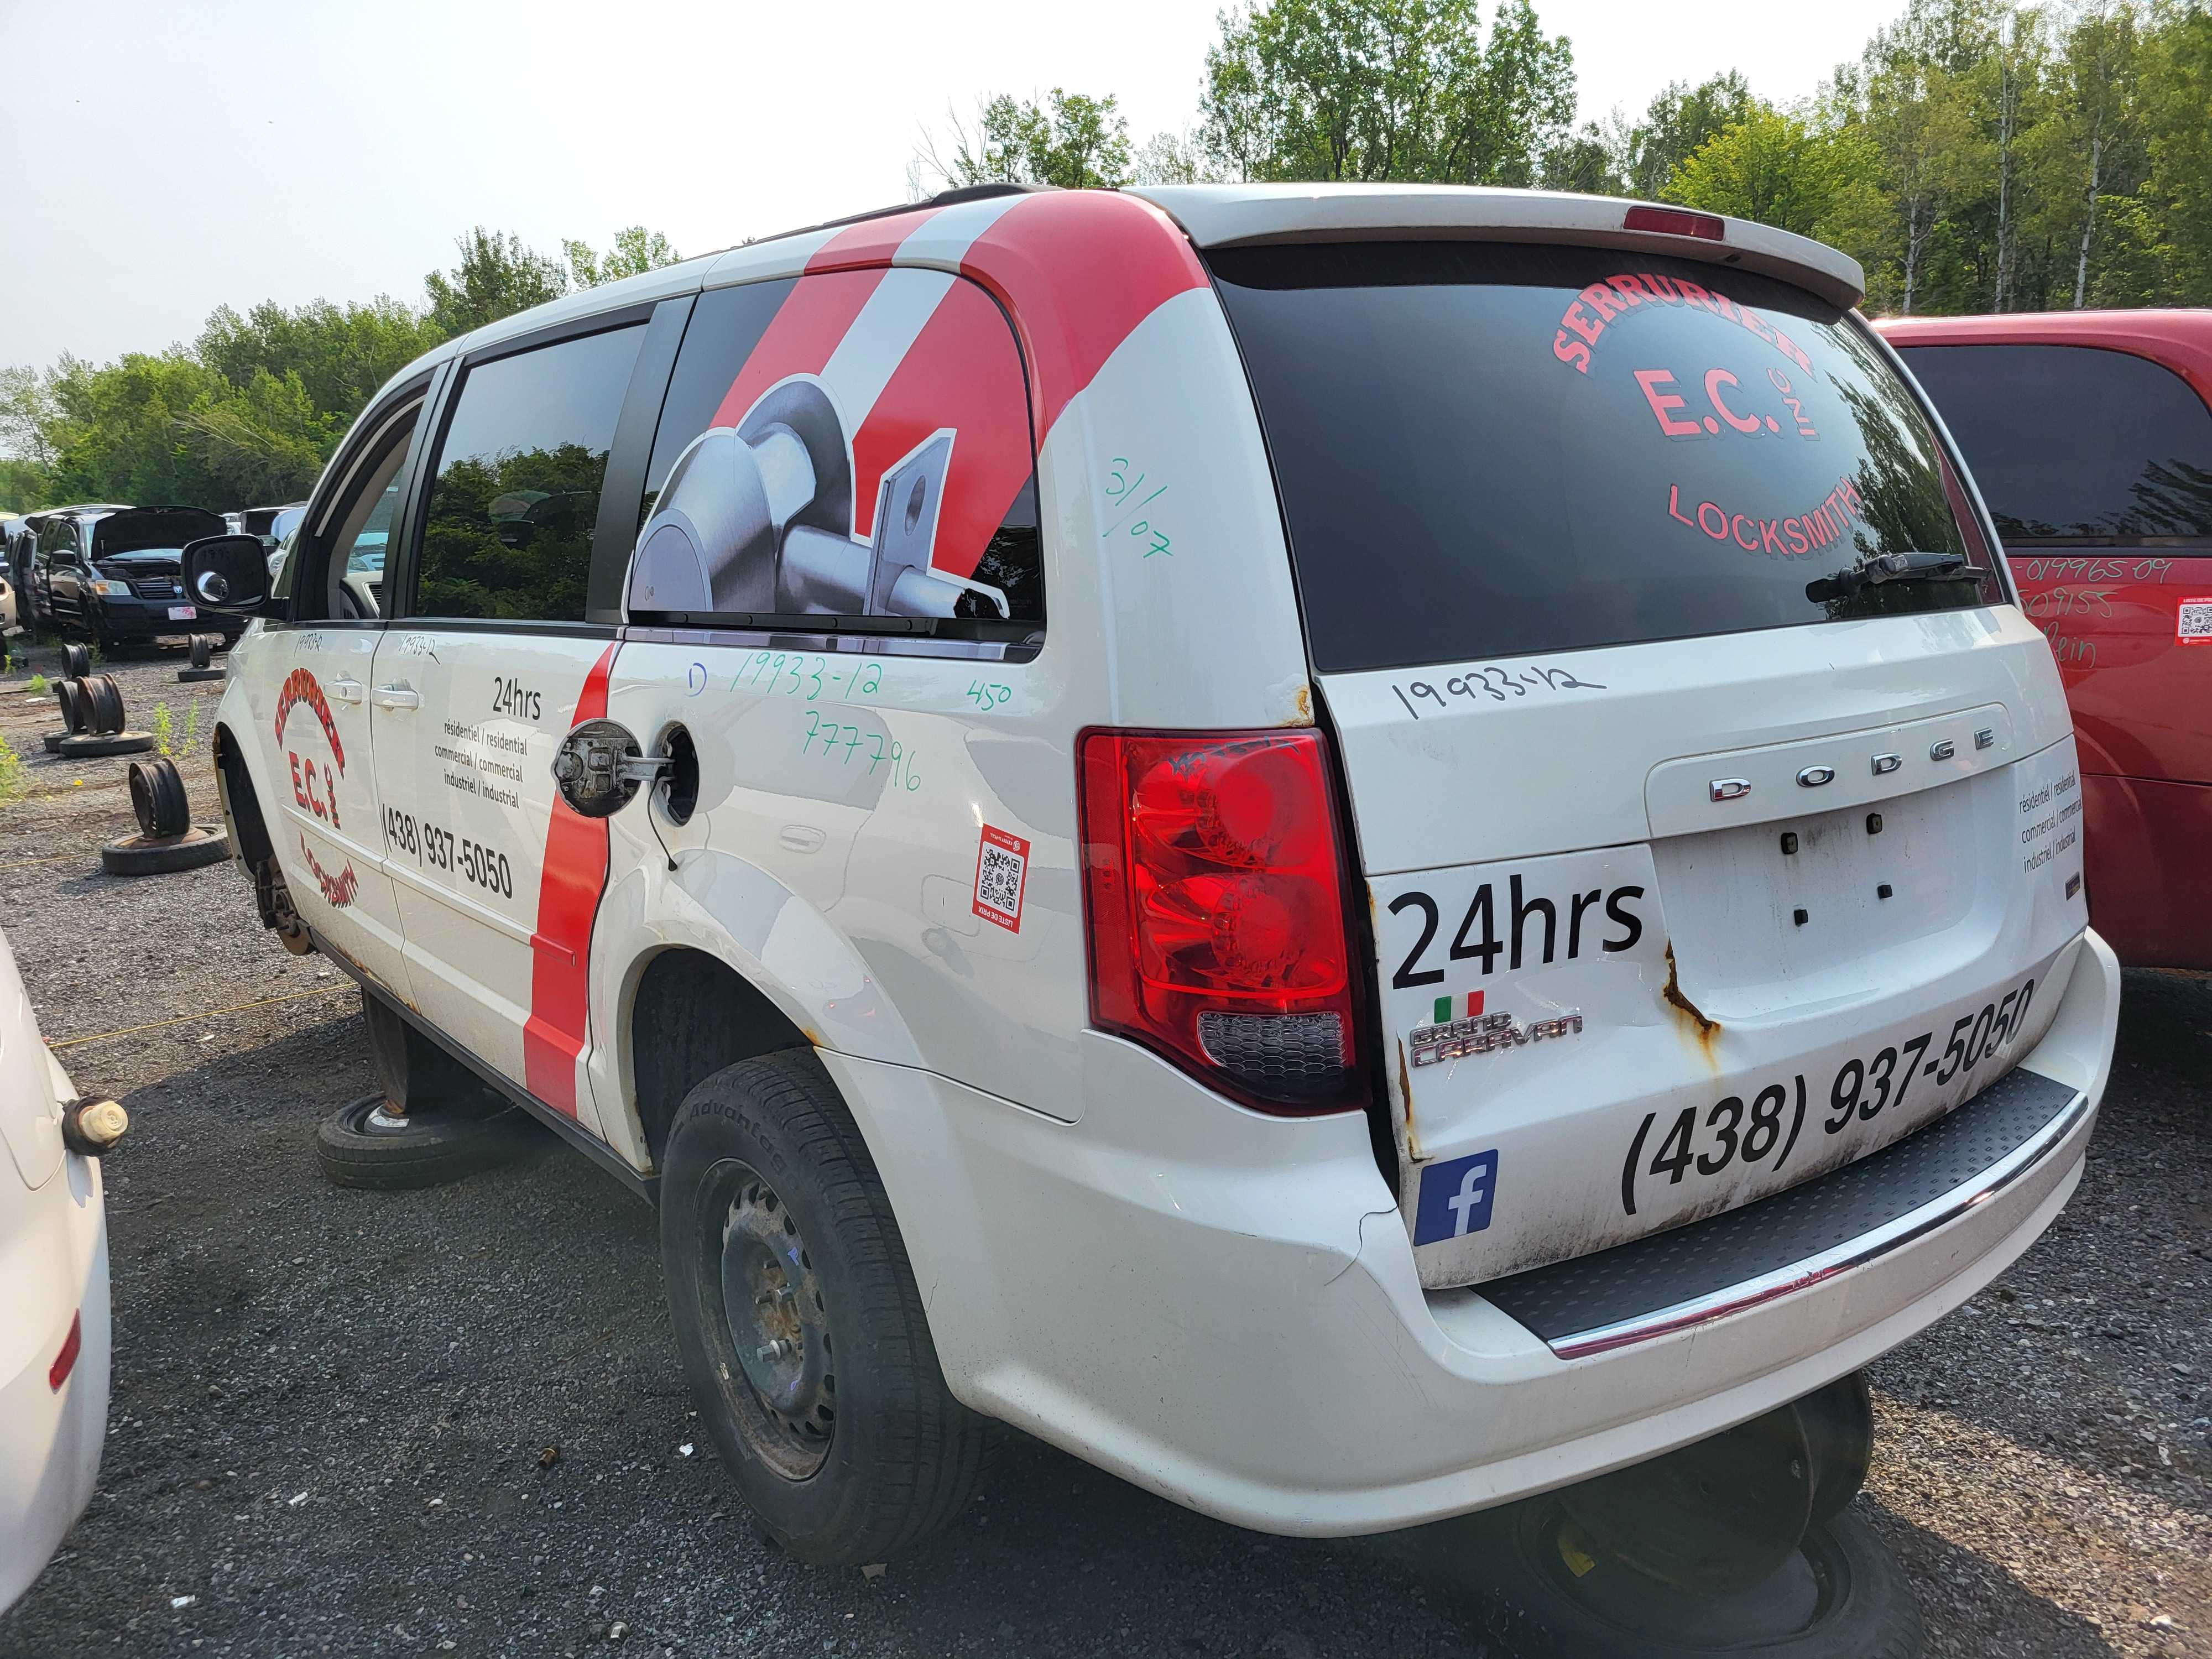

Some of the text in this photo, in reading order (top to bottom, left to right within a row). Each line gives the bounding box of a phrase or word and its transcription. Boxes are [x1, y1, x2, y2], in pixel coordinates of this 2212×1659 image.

[1552, 273, 1816, 379] SERRURIER
[1633, 367, 1780, 437] E.C.
[1667, 476, 1863, 555] LOCKSMITH
[493, 676, 541, 721] 24hrs
[730, 653, 883, 700] 19933-12
[966, 679, 1011, 711] 450
[444, 718, 480, 743] résidentiel
[487, 731, 528, 756] residential
[802, 711, 921, 791] 777796
[289, 750, 328, 822] E.C.
[435, 745, 473, 768] commercial
[479, 757, 523, 783] commercial
[1709, 727, 1995, 802] DODGE
[444, 769, 477, 795] industriel
[483, 780, 519, 809] industrial
[2019, 785, 2051, 815] résidentiel
[2053, 769, 2076, 796] residential
[2021, 810, 2056, 844] commercial
[2059, 795, 2082, 823] commercial
[383, 804, 513, 899] (438) 937-5050
[2023, 843, 2052, 874] industriel
[2056, 826, 2076, 855] industrial
[978, 905, 1013, 928] LISTE DE PRIX
[1387, 874, 1645, 989] 24hrs
[1410, 1011, 1512, 1046] GRAND
[1411, 1015, 1584, 1067] CARAVAN
[1621, 978, 2035, 1215] (438) 937-5050
